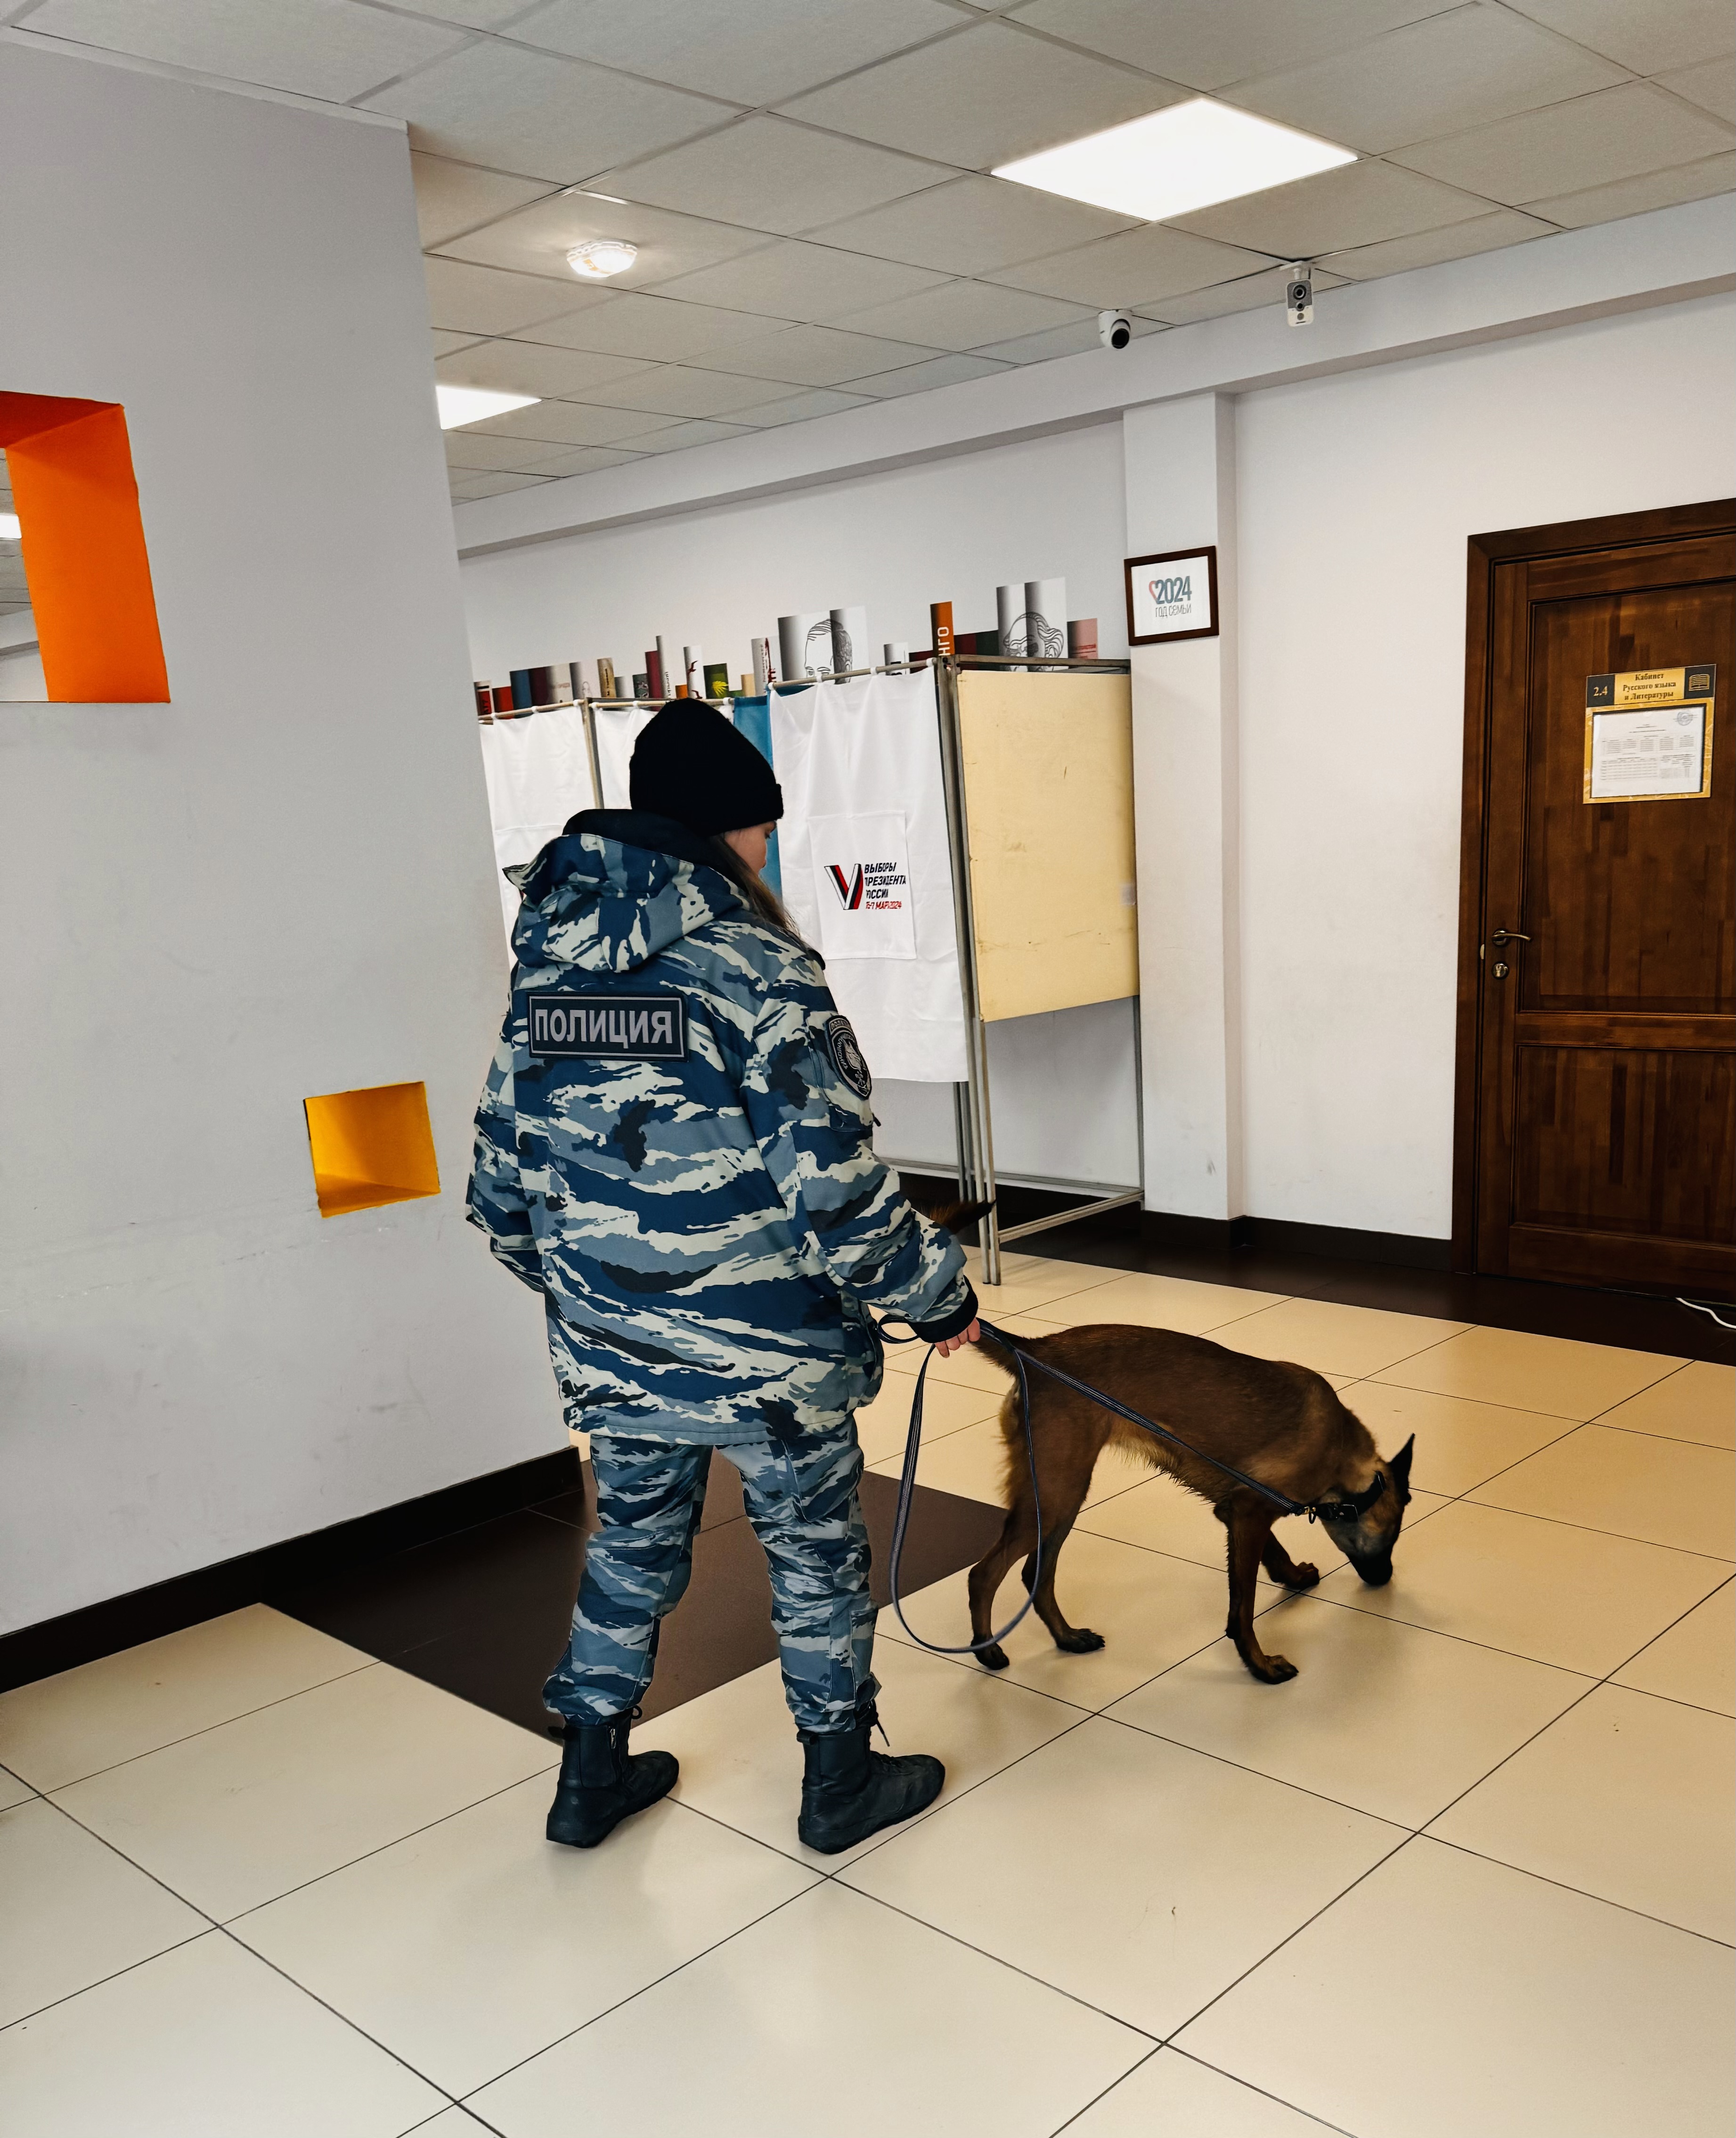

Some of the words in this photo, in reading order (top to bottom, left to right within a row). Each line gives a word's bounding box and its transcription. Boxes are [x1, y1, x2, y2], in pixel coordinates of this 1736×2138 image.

[1155, 576, 1192, 604] 2024
[1156, 606, 1167, 618] ГОД
[1169, 603, 1191, 616] СЕМЬИ
[1635, 673, 1664, 681] Кабинет
[1593, 685, 1608, 696] 2.4
[1623, 683, 1653, 692] Русского
[1630, 691, 1674, 700] Литературы
[535, 1009, 673, 1049] ПОЛИЦИЯ
